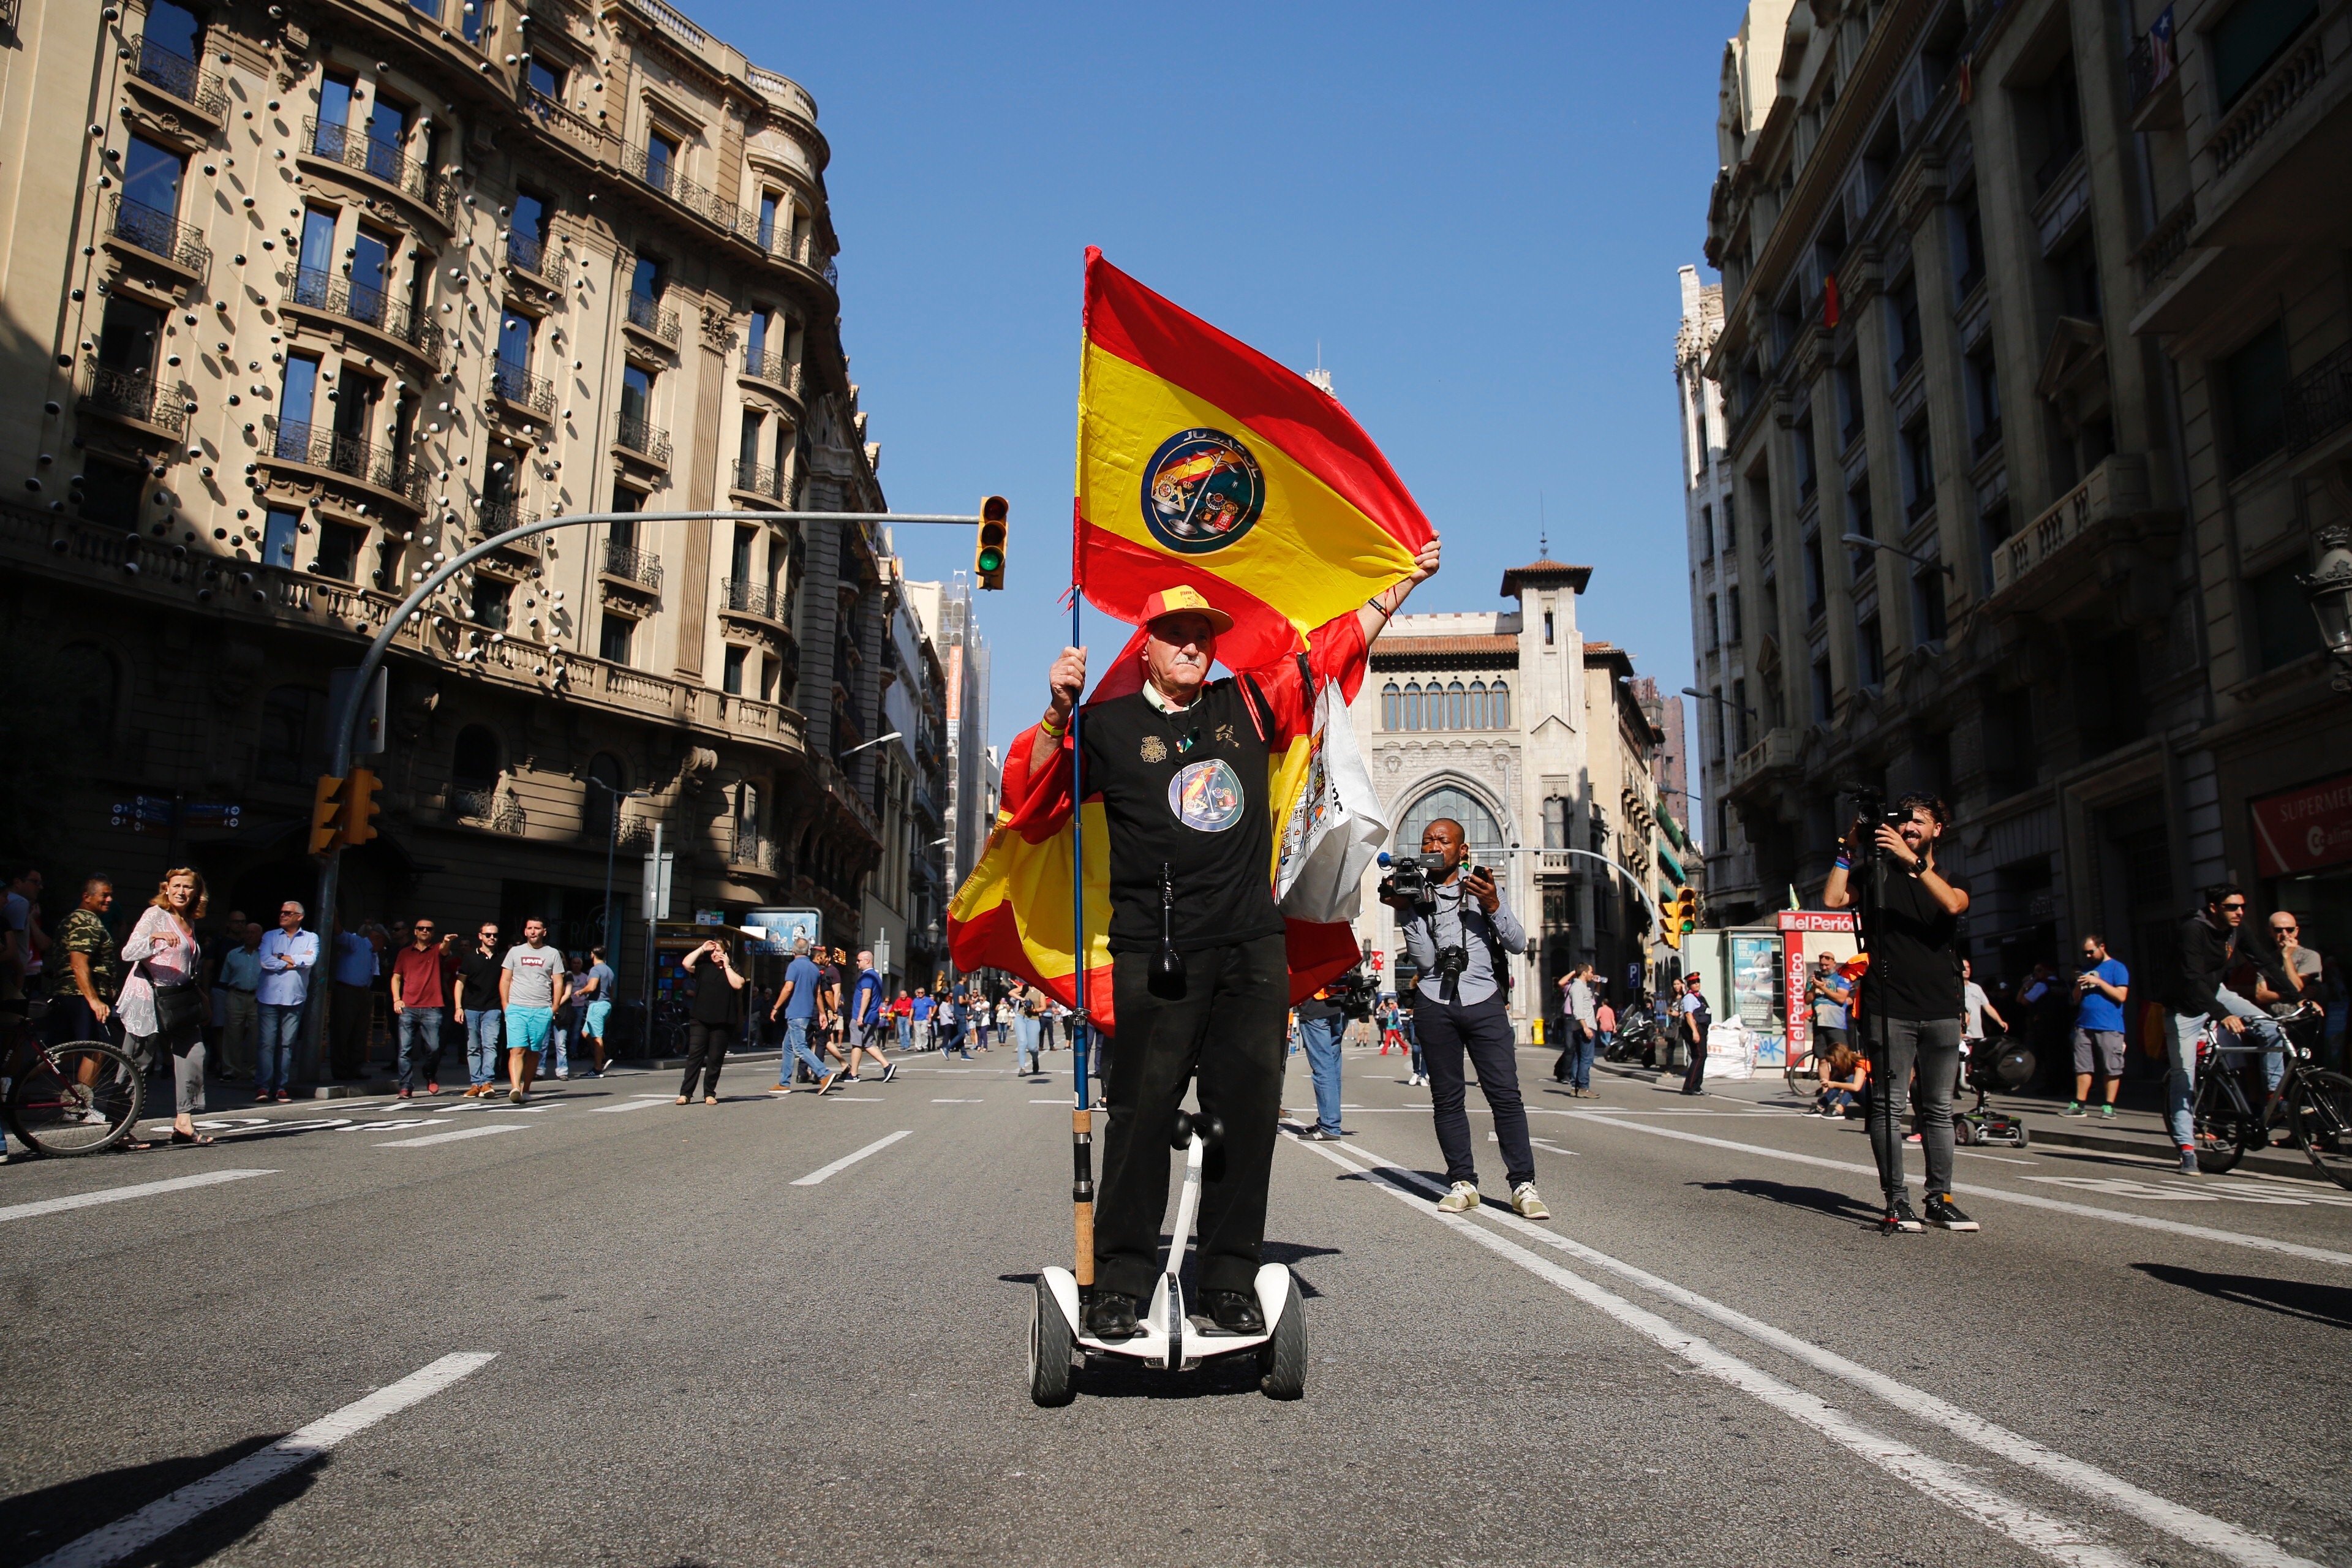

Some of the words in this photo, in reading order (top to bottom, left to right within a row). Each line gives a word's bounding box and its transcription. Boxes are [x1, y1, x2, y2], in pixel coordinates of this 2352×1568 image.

[1183, 431, 1259, 478] JUSAPOL
[1795, 916, 1809, 930] el
[1630, 965, 1637, 979] P
[1789, 952, 1804, 1025] Periódico
[1790, 1027, 1804, 1041] el
[307, 1101, 567, 1112] TAXI
[149, 1118, 459, 1133] BUS
[2016, 1176, 2352, 1207] BUS
